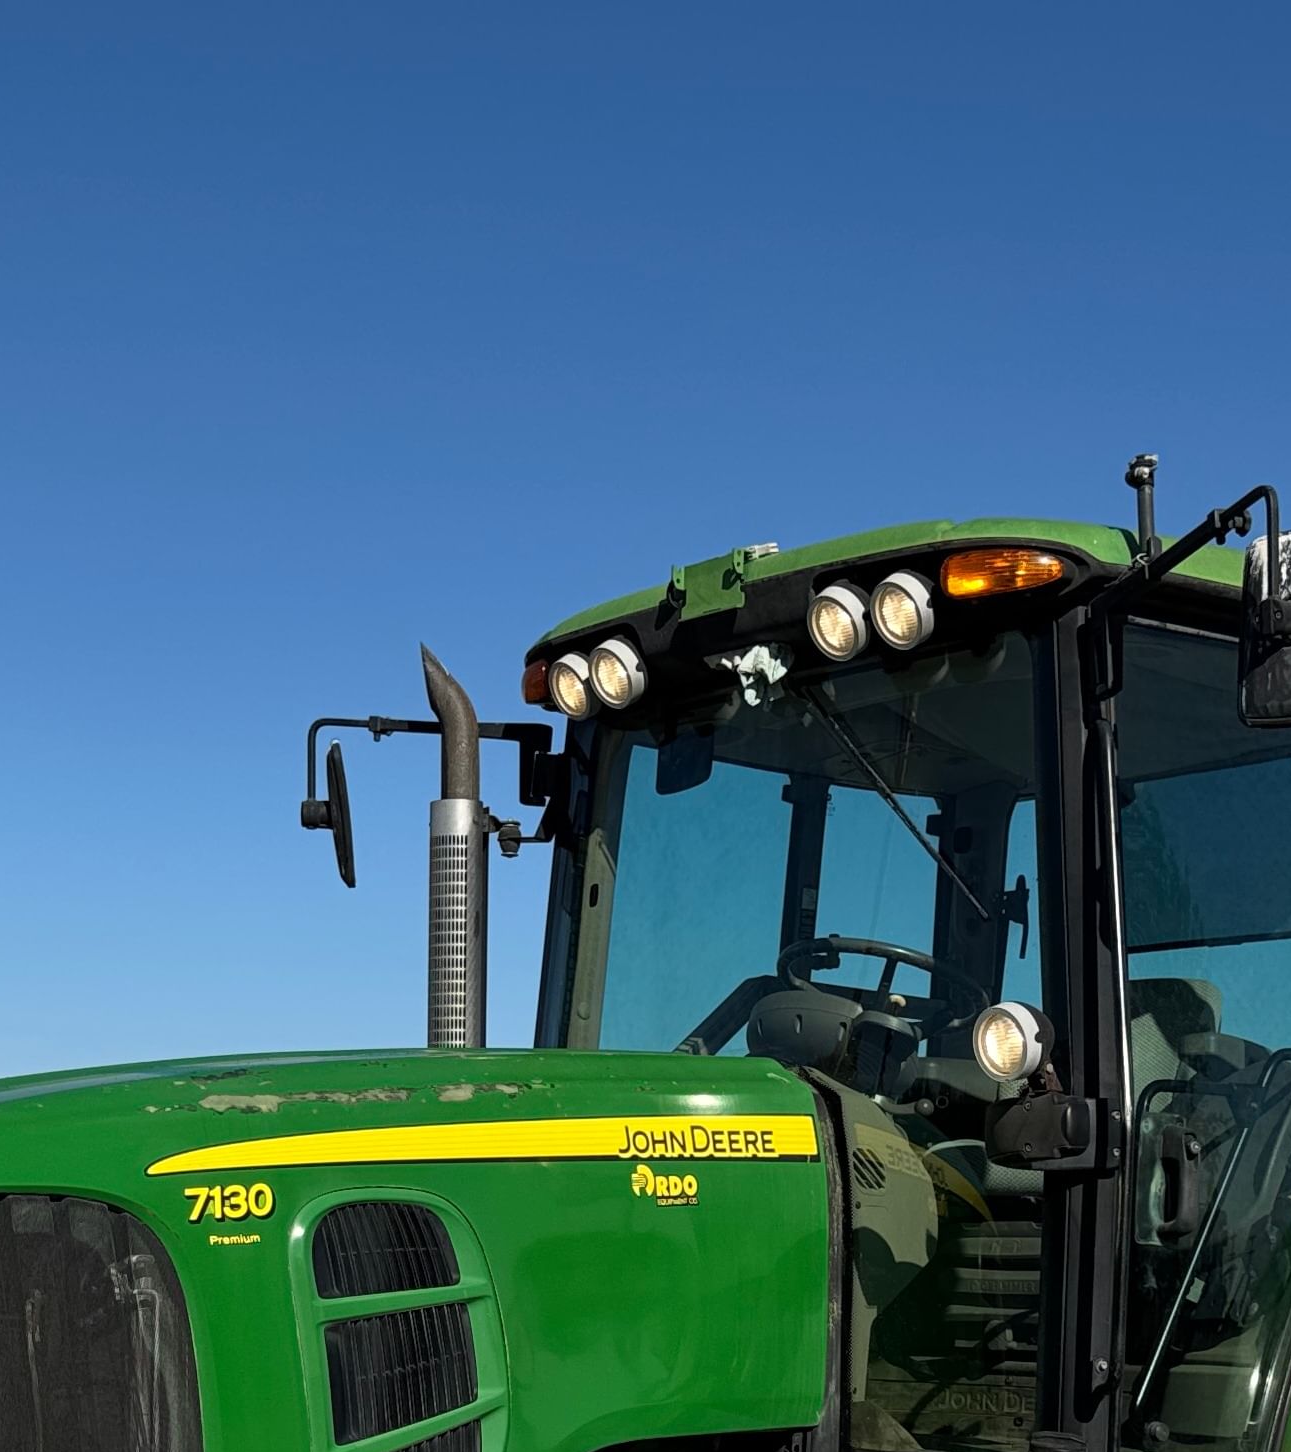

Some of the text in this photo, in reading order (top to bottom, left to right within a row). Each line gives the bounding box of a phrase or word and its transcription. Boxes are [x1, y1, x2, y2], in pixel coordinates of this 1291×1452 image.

[618, 1125, 776, 1154] JOHN DEERE
[184, 1183, 274, 1223] 7130
[209, 1233, 261, 1245] Premium
[938, 1388, 998, 1412] JOHN
